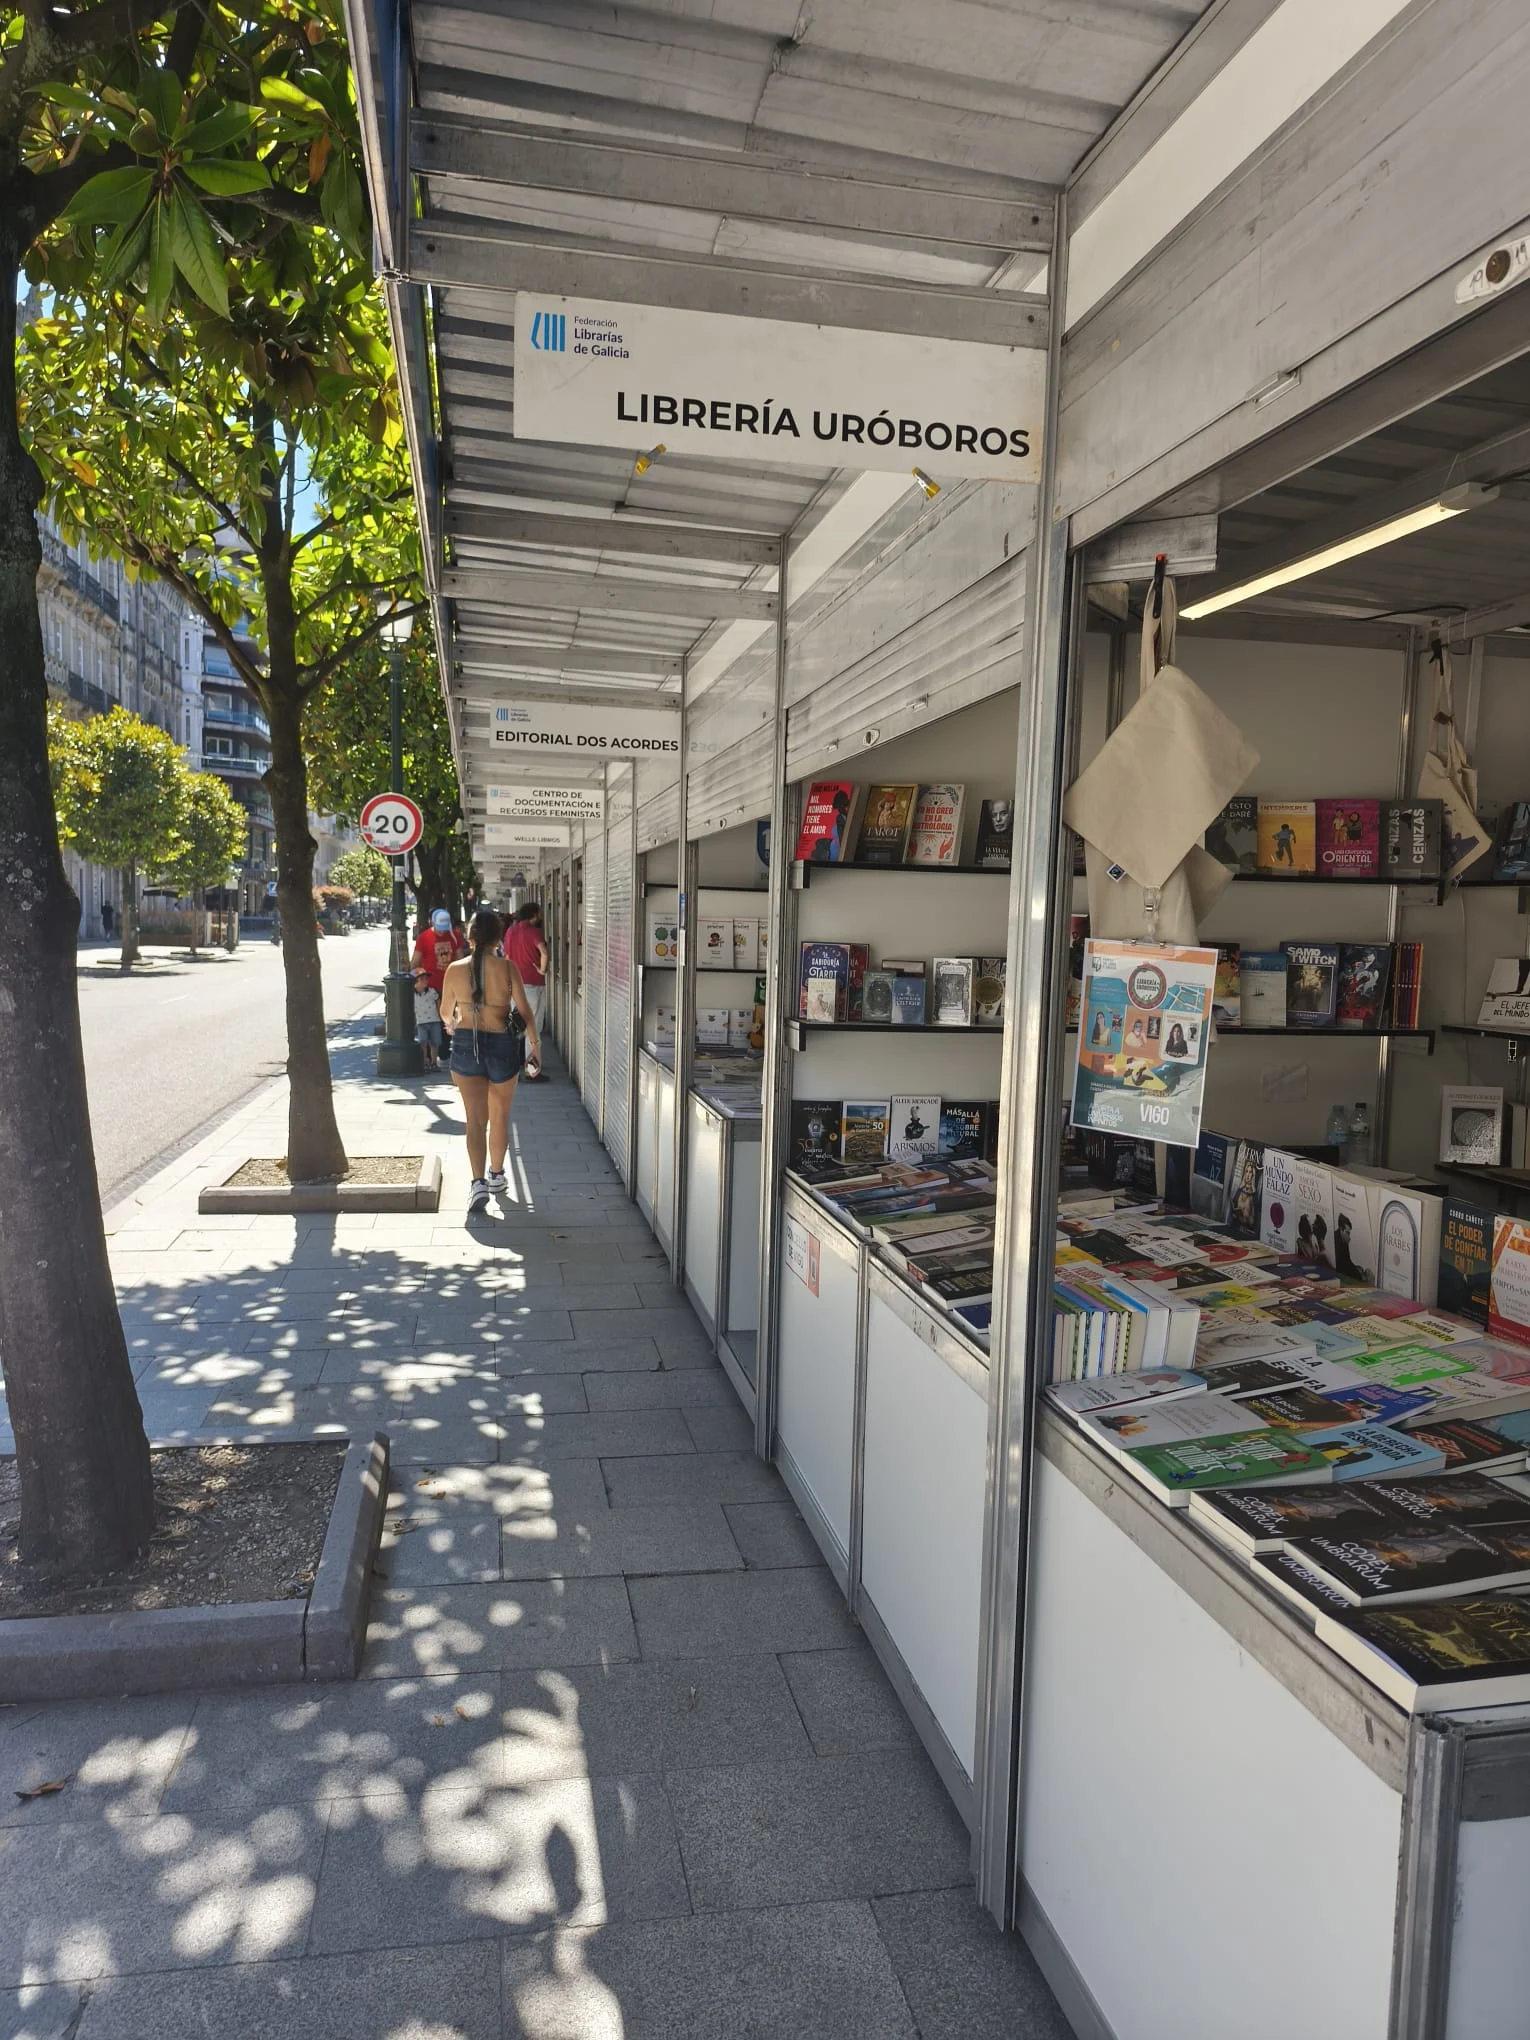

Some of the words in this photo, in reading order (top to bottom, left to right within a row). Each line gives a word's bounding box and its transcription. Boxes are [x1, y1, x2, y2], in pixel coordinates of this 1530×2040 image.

[574, 316, 618, 328] Federación
[574, 328, 623, 343] Librarías
[574, 344, 588, 354] de
[591, 345, 629, 359] Galicia
[617, 391, 801, 437] LIBRERÍA
[813, 410, 1030, 457] URÓBOROS
[496, 730, 573, 746] EDITORIAL
[577, 735, 607, 748] DOS
[611, 737, 678, 751] ACORDES
[532, 790, 568, 798] CENTRO
[570, 791, 583, 799] DE
[514, 798, 593, 809] DOCUMENTACIÓN
[1229, 802, 1252, 810] ESTO
[500, 807, 548, 816] RECURSOS
[549, 809, 601, 818] FEMINISTAS
[1229, 810, 1252, 818] DARÉ
[375, 814, 408, 834] 20
[1412, 808, 1425, 864] CENIZAS
[1322, 850, 1373, 863] ORIENTAL
[1291, 955, 1336, 965] TWITCH
[1500, 1000, 1509, 1009] EL
[1511, 1001, 1530, 1010] JEFE
[1504, 1008, 1530, 1018] MUNDO
[1140, 1103, 1170, 1126] VIGO
[872, 1122, 884, 1130] 50
[1273, 1156, 1285, 1169] UN
[1265, 1167, 1294, 1184] MUNDO
[1266, 1179, 1290, 1196] FALAZ
[1298, 1183, 1322, 1203] SEXO
[1448, 1221, 1457, 1236] EL
[1458, 1223, 1484, 1243] PODER
[1444, 1235, 1454, 1250] DE
[1454, 1238, 1487, 1261] CONFIAR
[1300, 1356, 1323, 1368] LA
[1341, 1431, 1407, 1461] DESNORTADA
[1357, 1427, 1370, 1436] LA
[1371, 1432, 1423, 1457] DERECHA
[1391, 1486, 1443, 1514] CODEX
[1214, 1489, 1284, 1536] UMBRARUM
[1242, 1495, 1289, 1523] CODEX
[1309, 1536, 1393, 1590] UMBRARUM
[1340, 1541, 1396, 1575] CODEX
